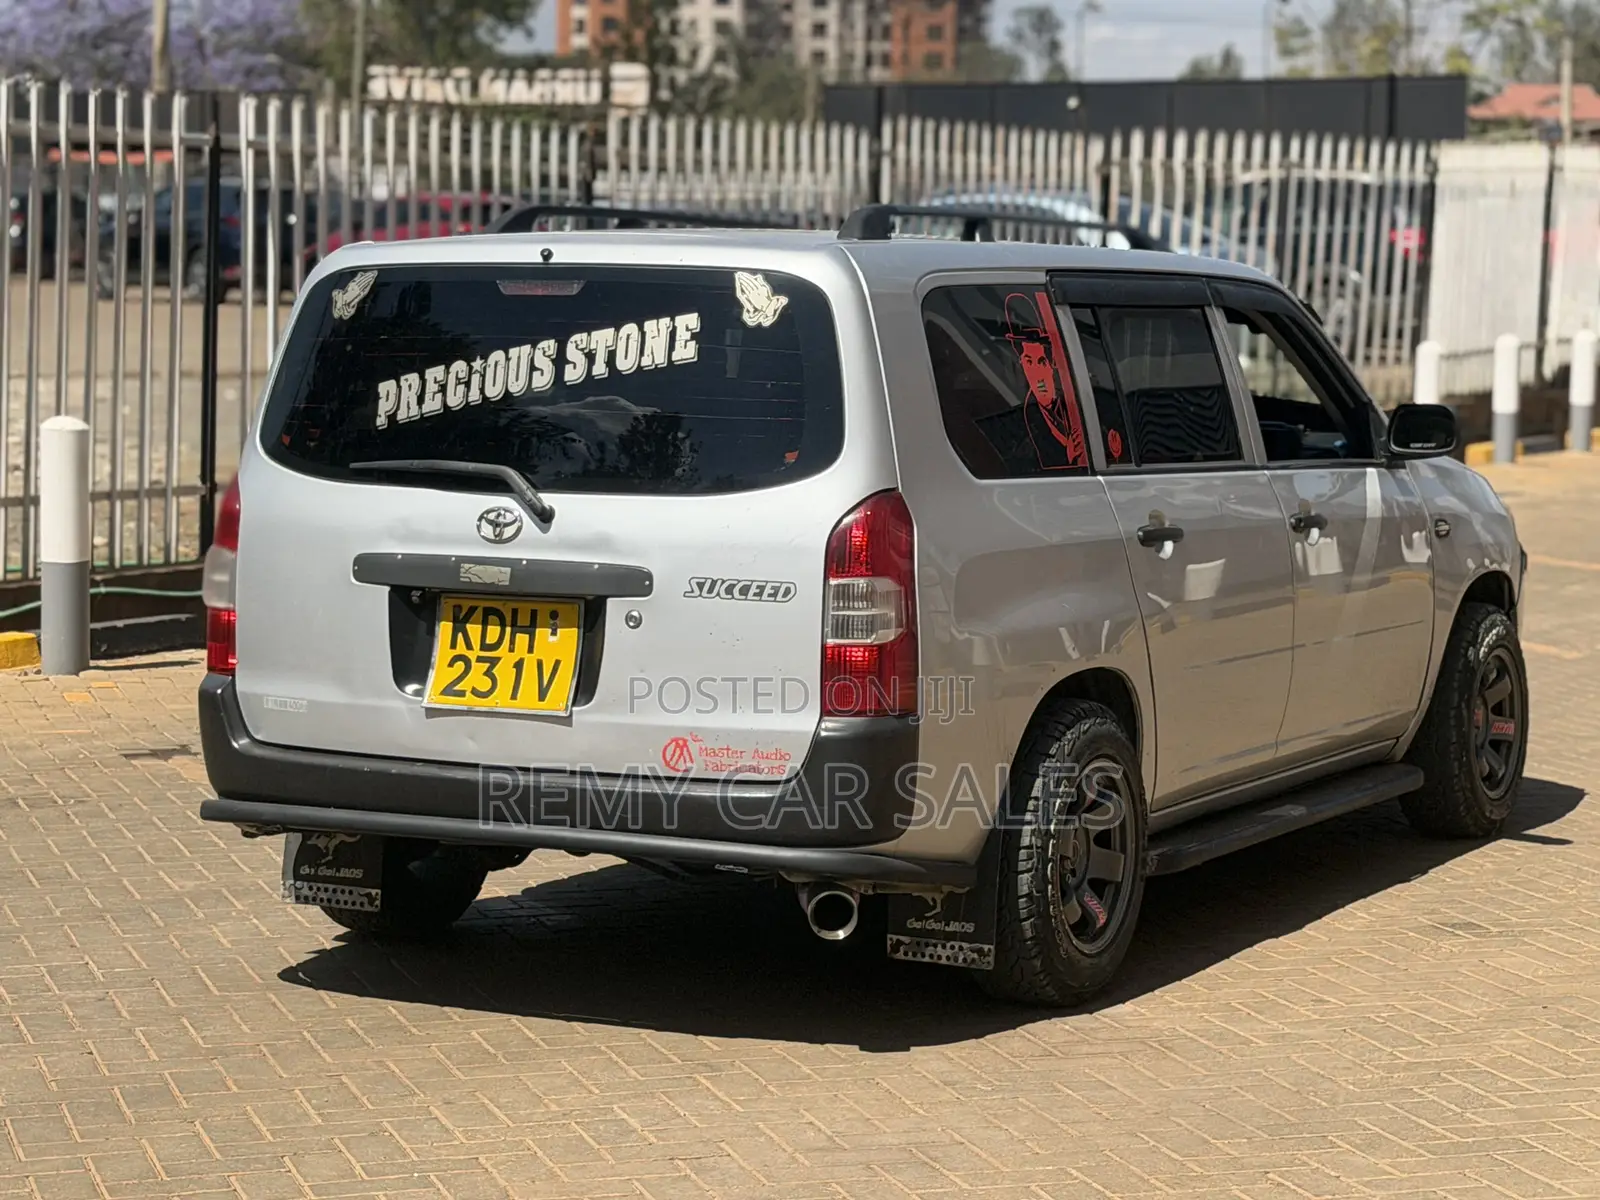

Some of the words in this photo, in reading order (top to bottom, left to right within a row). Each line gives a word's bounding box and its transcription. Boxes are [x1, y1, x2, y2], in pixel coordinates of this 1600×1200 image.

[564, 312, 701, 385] STONE
[682, 576, 797, 603] SUCCEED
[449, 604, 538, 655] KDH
[439, 653, 562, 703] 231V
[697, 744, 746, 760] Master
[751, 747, 792, 762] Audio
